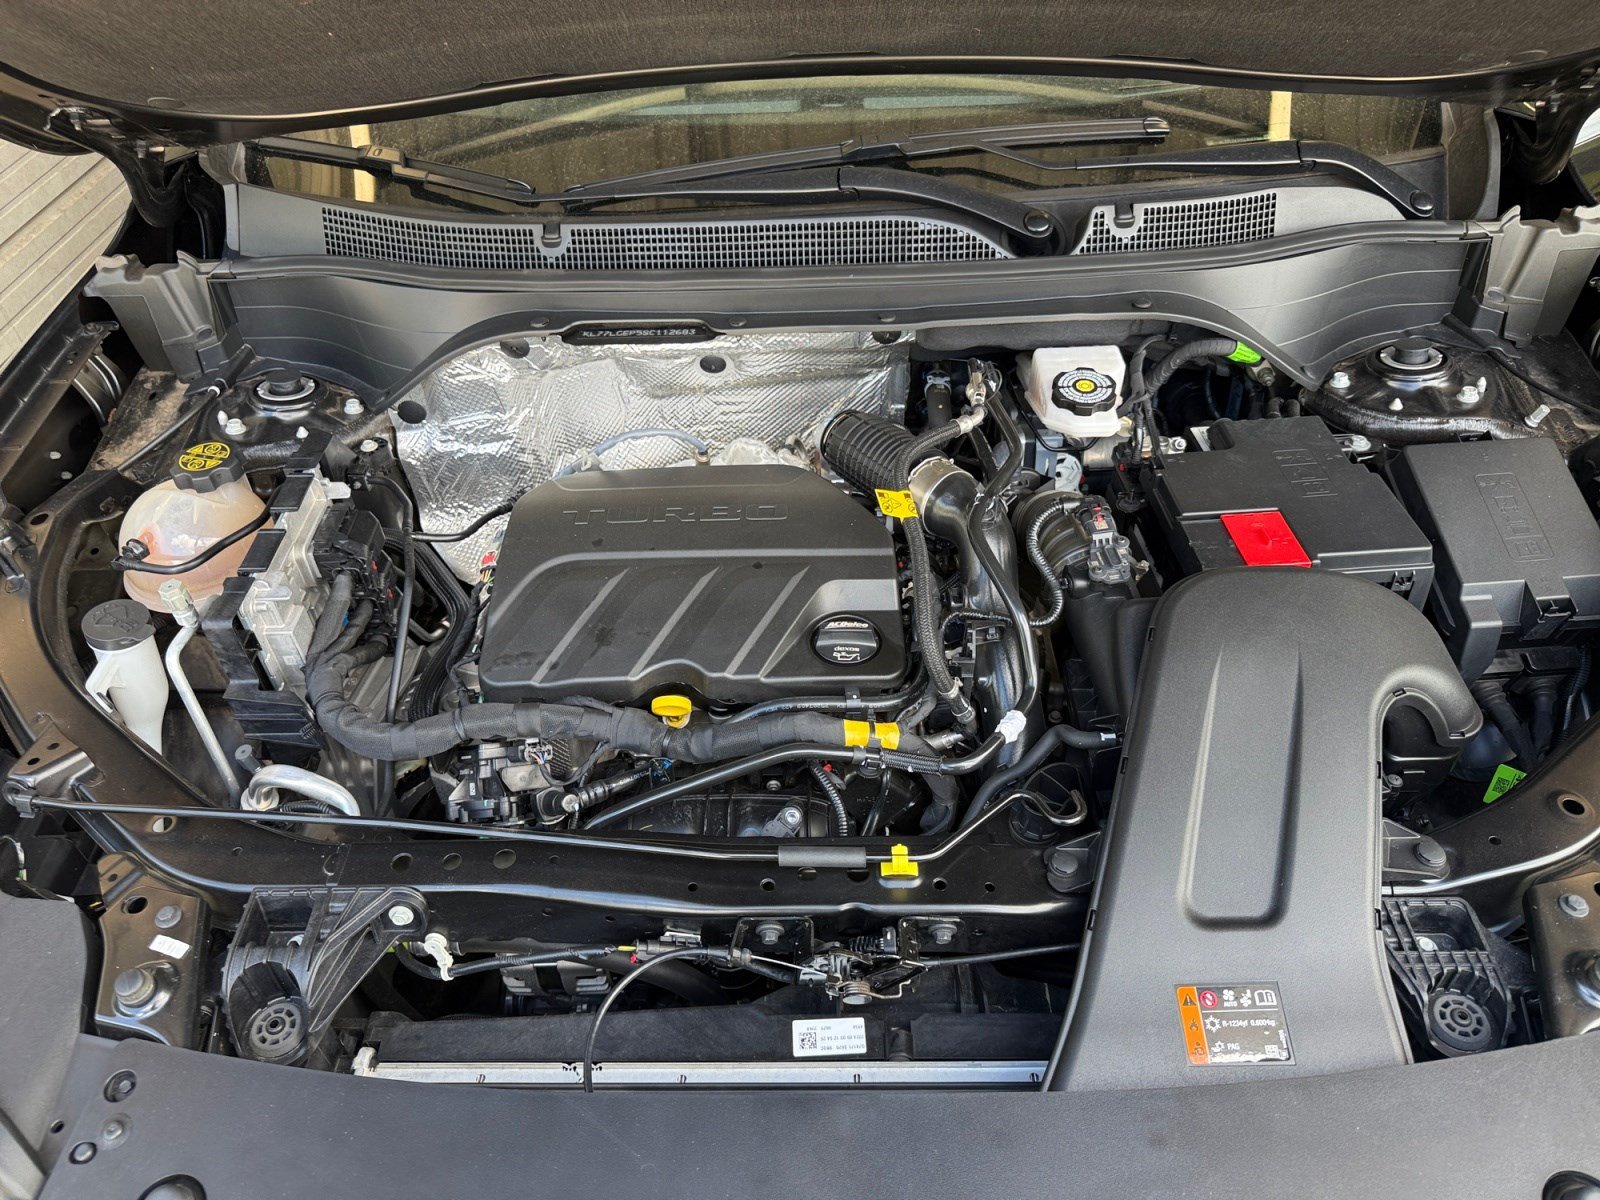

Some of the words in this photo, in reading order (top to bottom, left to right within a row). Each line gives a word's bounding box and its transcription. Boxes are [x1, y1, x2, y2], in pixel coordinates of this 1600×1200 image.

[562, 505, 788, 525] TURBO
[824, 621, 869, 629] ACDelco
[1227, 1042, 1241, 1050] PAG
